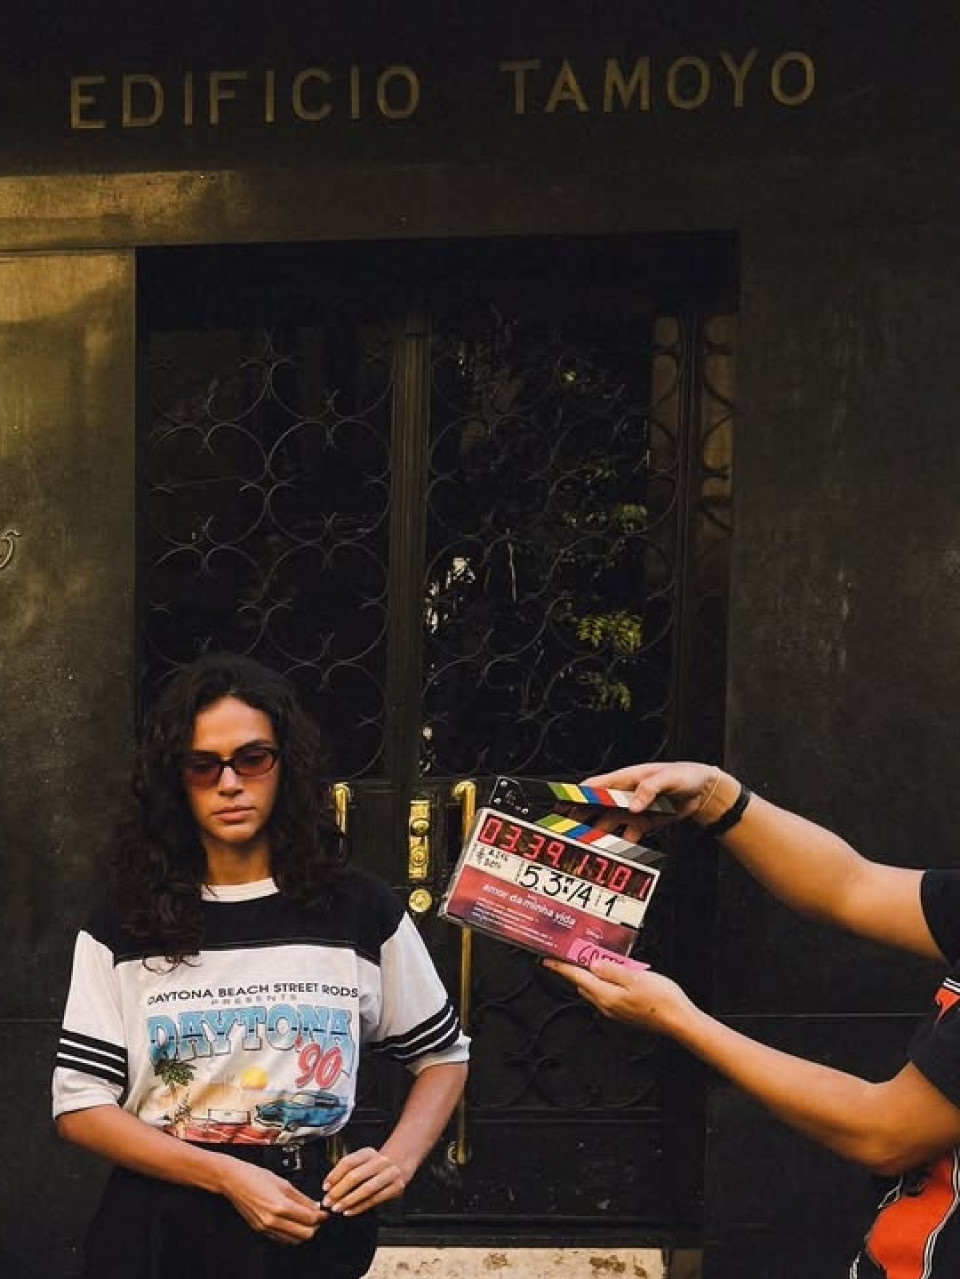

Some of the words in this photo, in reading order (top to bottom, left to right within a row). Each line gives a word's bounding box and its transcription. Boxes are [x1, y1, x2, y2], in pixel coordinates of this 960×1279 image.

[70, 65, 421, 130] EDIFICIO
[499, 49, 817, 116] TAMOYO
[147, 986, 214, 1006] DAYTONA
[218, 983, 270, 998] BEACH
[273, 982, 319, 993] STREET
[321, 984, 359, 998] RODS
[147, 1003, 356, 1066] DAYTONA
